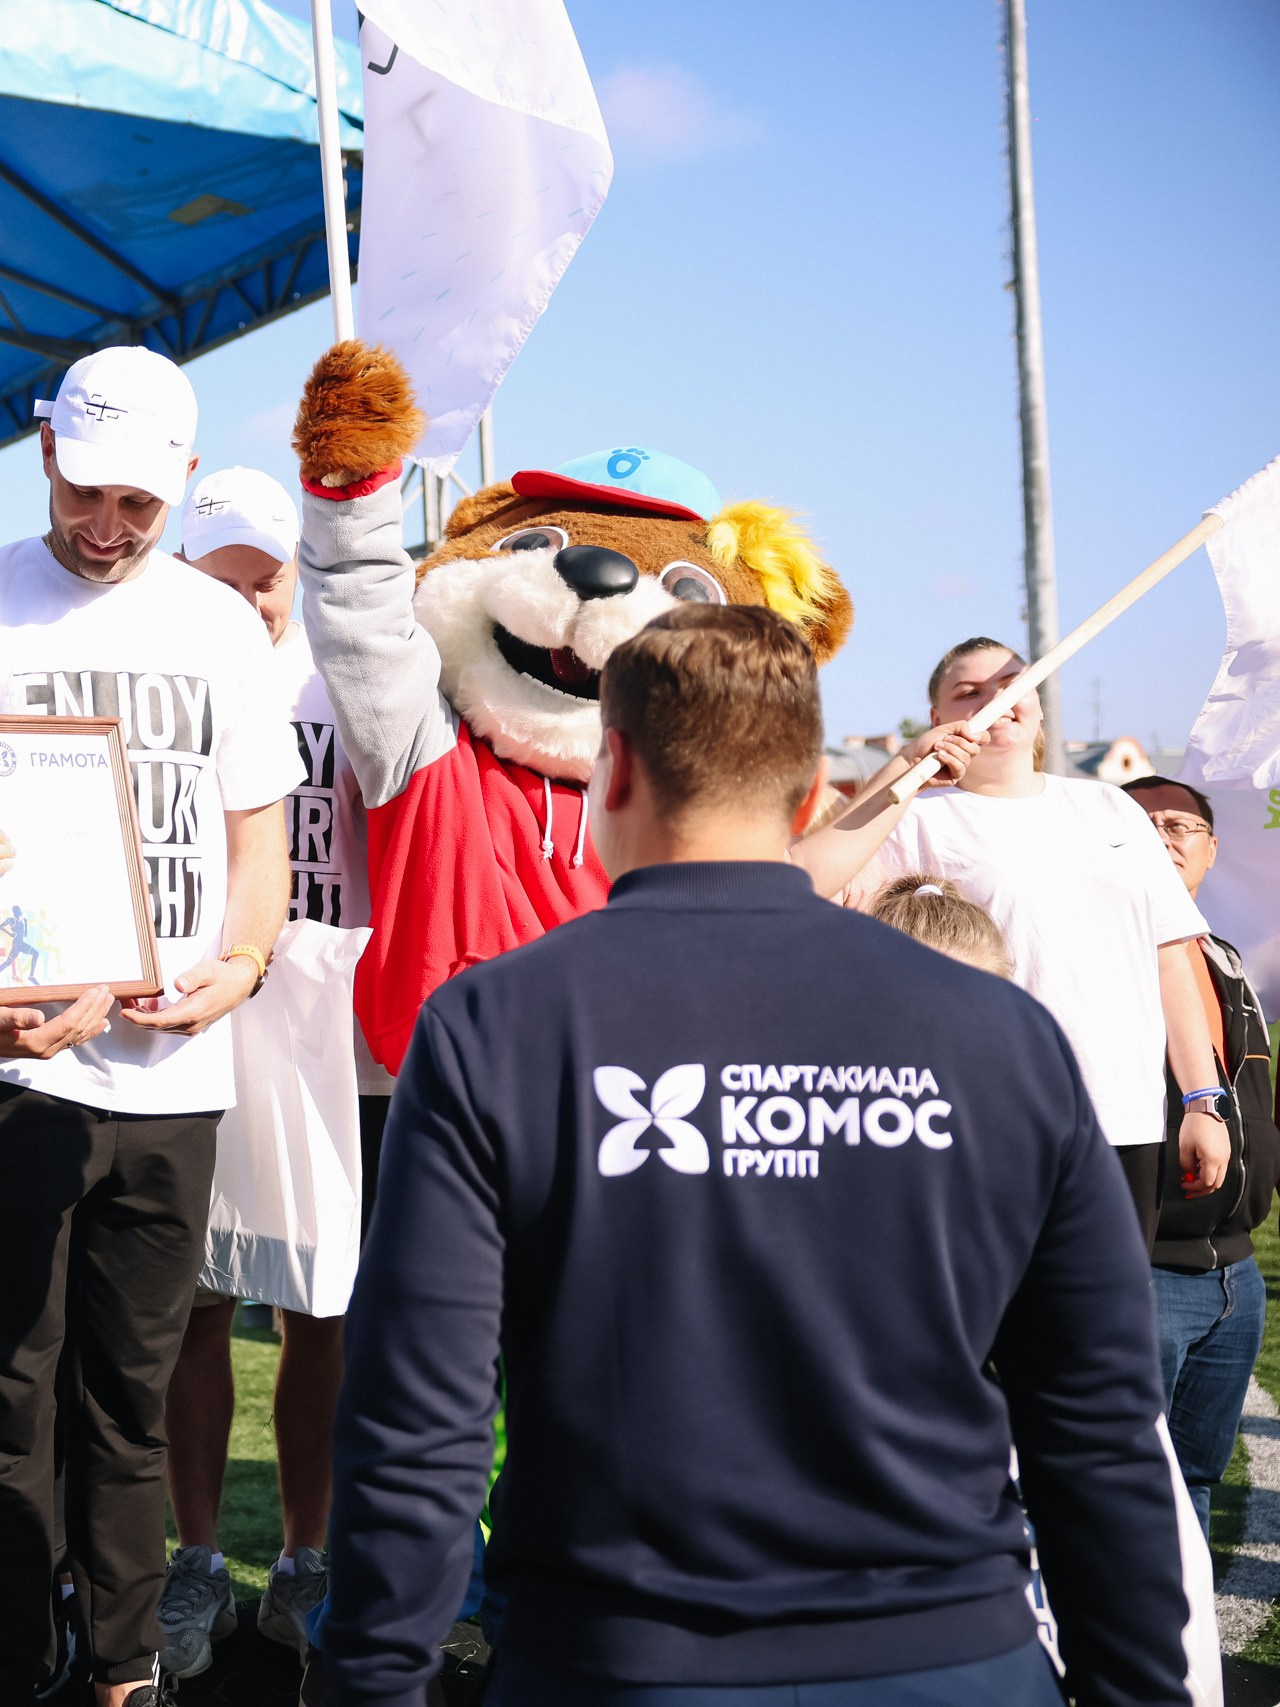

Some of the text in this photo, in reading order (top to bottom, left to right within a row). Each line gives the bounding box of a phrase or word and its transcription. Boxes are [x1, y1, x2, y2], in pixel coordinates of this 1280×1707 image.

[30, 752, 109, 768] ГРАМОТА
[721, 1064, 939, 1099] СПАРТАКИАДА
[721, 1096, 953, 1149] КОМОС
[723, 1149, 819, 1177] ГРУПП
